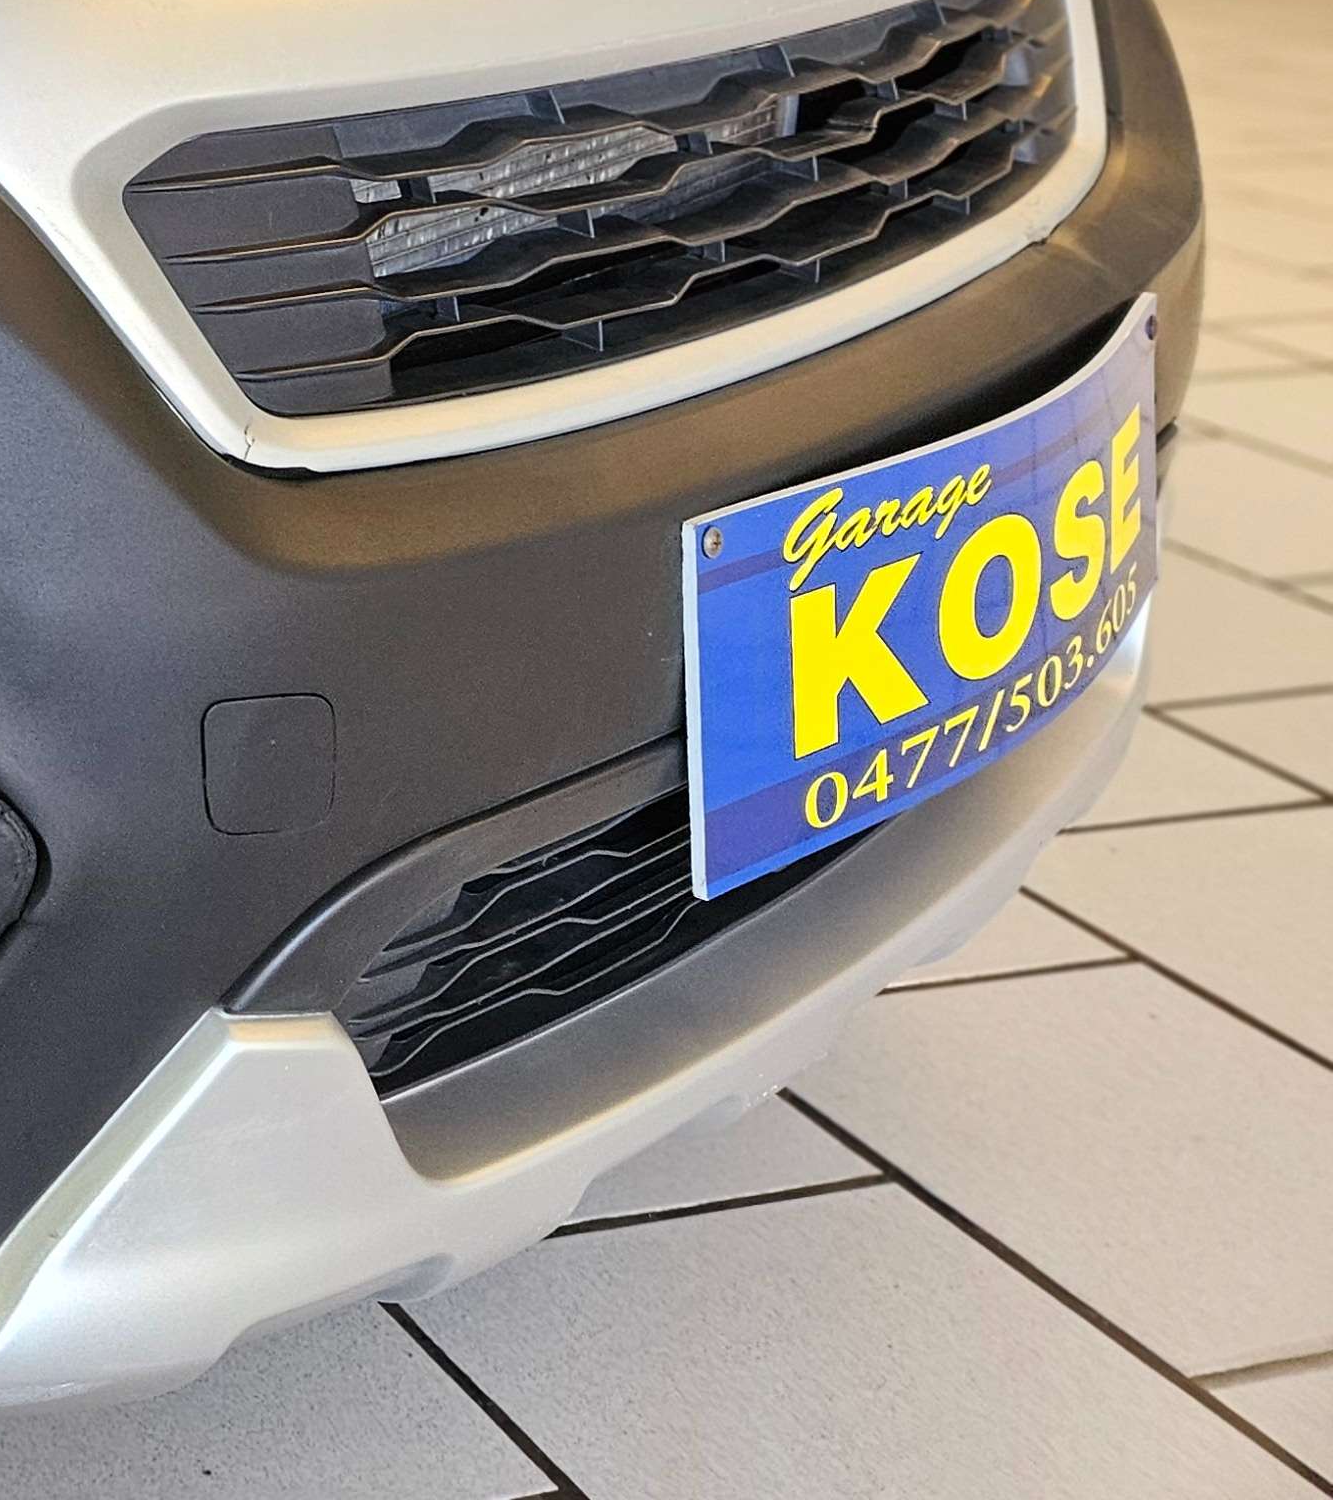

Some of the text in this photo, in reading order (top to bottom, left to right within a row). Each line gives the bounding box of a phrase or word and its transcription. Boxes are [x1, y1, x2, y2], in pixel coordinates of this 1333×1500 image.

[782, 463, 991, 591] Garage
[790, 404, 1141, 759] KOSE
[804, 565, 1138, 828] 0477/503.605
